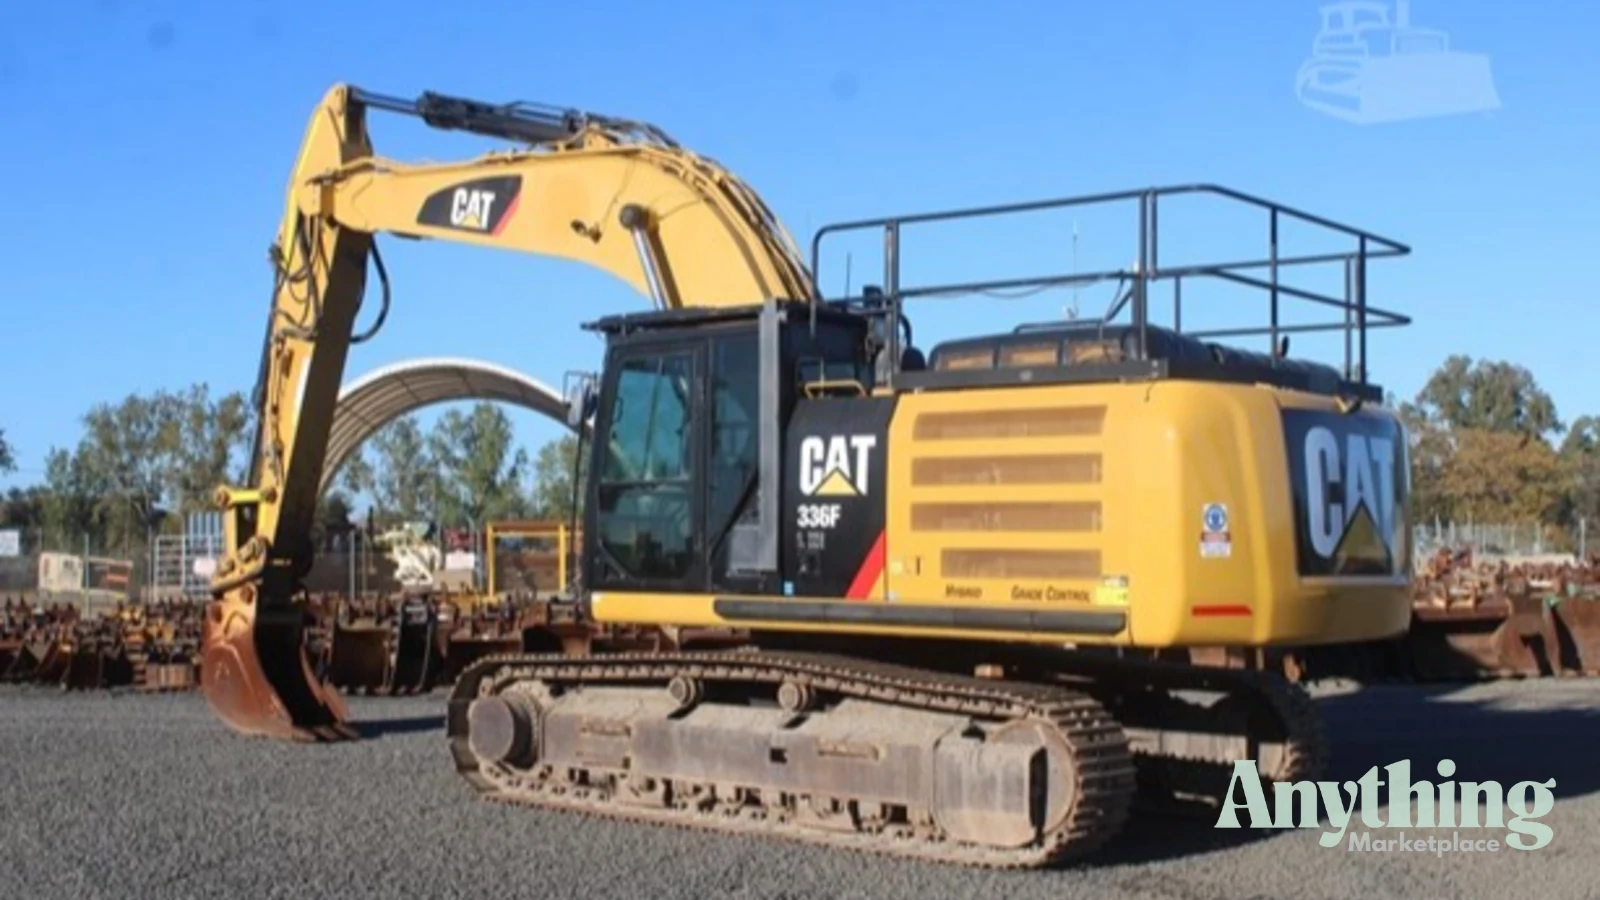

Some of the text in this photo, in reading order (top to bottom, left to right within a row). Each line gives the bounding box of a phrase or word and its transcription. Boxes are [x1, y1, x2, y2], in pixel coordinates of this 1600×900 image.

[450, 187, 496, 230] CAT
[800, 434, 877, 496] CAT
[797, 504, 841, 528] 336F
[1304, 426, 1395, 559] CAT
